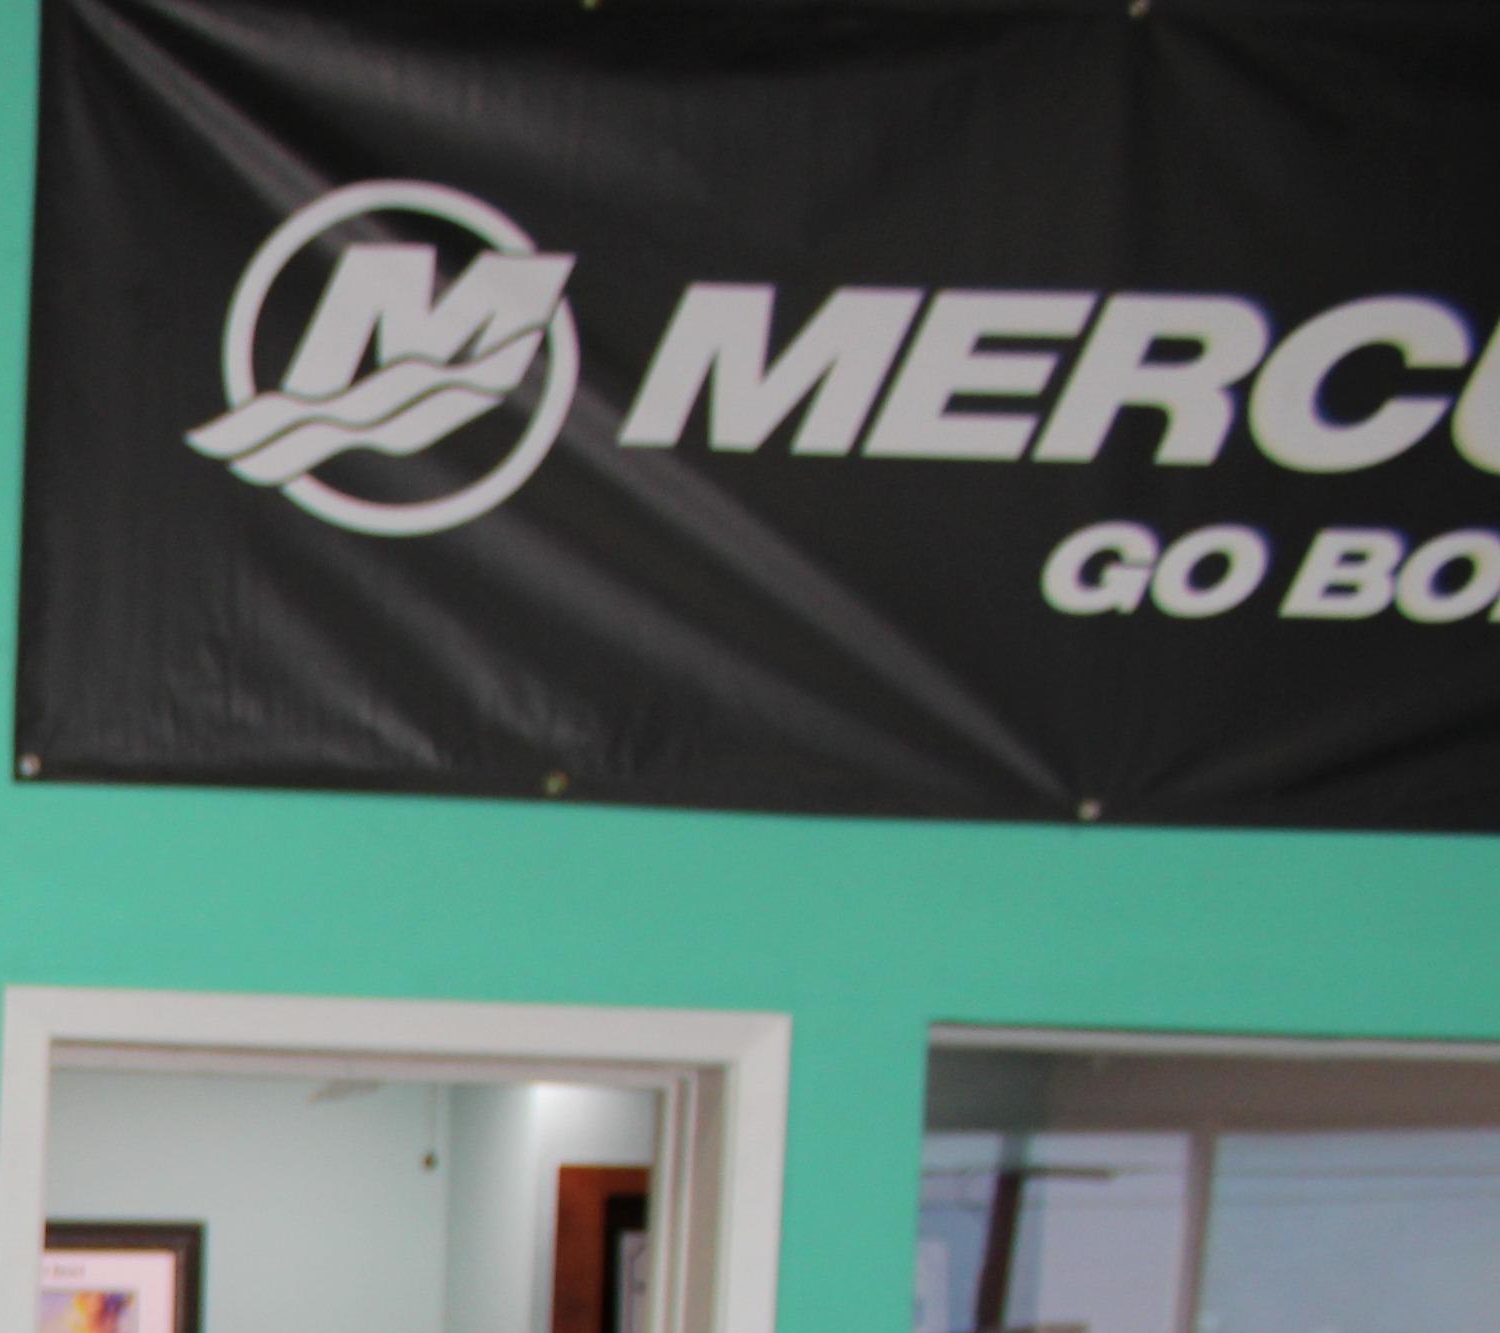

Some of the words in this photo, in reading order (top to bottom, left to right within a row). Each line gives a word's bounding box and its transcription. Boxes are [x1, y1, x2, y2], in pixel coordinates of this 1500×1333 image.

[617, 284, 1500, 475] MERC
[1041, 520, 1271, 620] GO
[1278, 526, 1500, 625] BO
